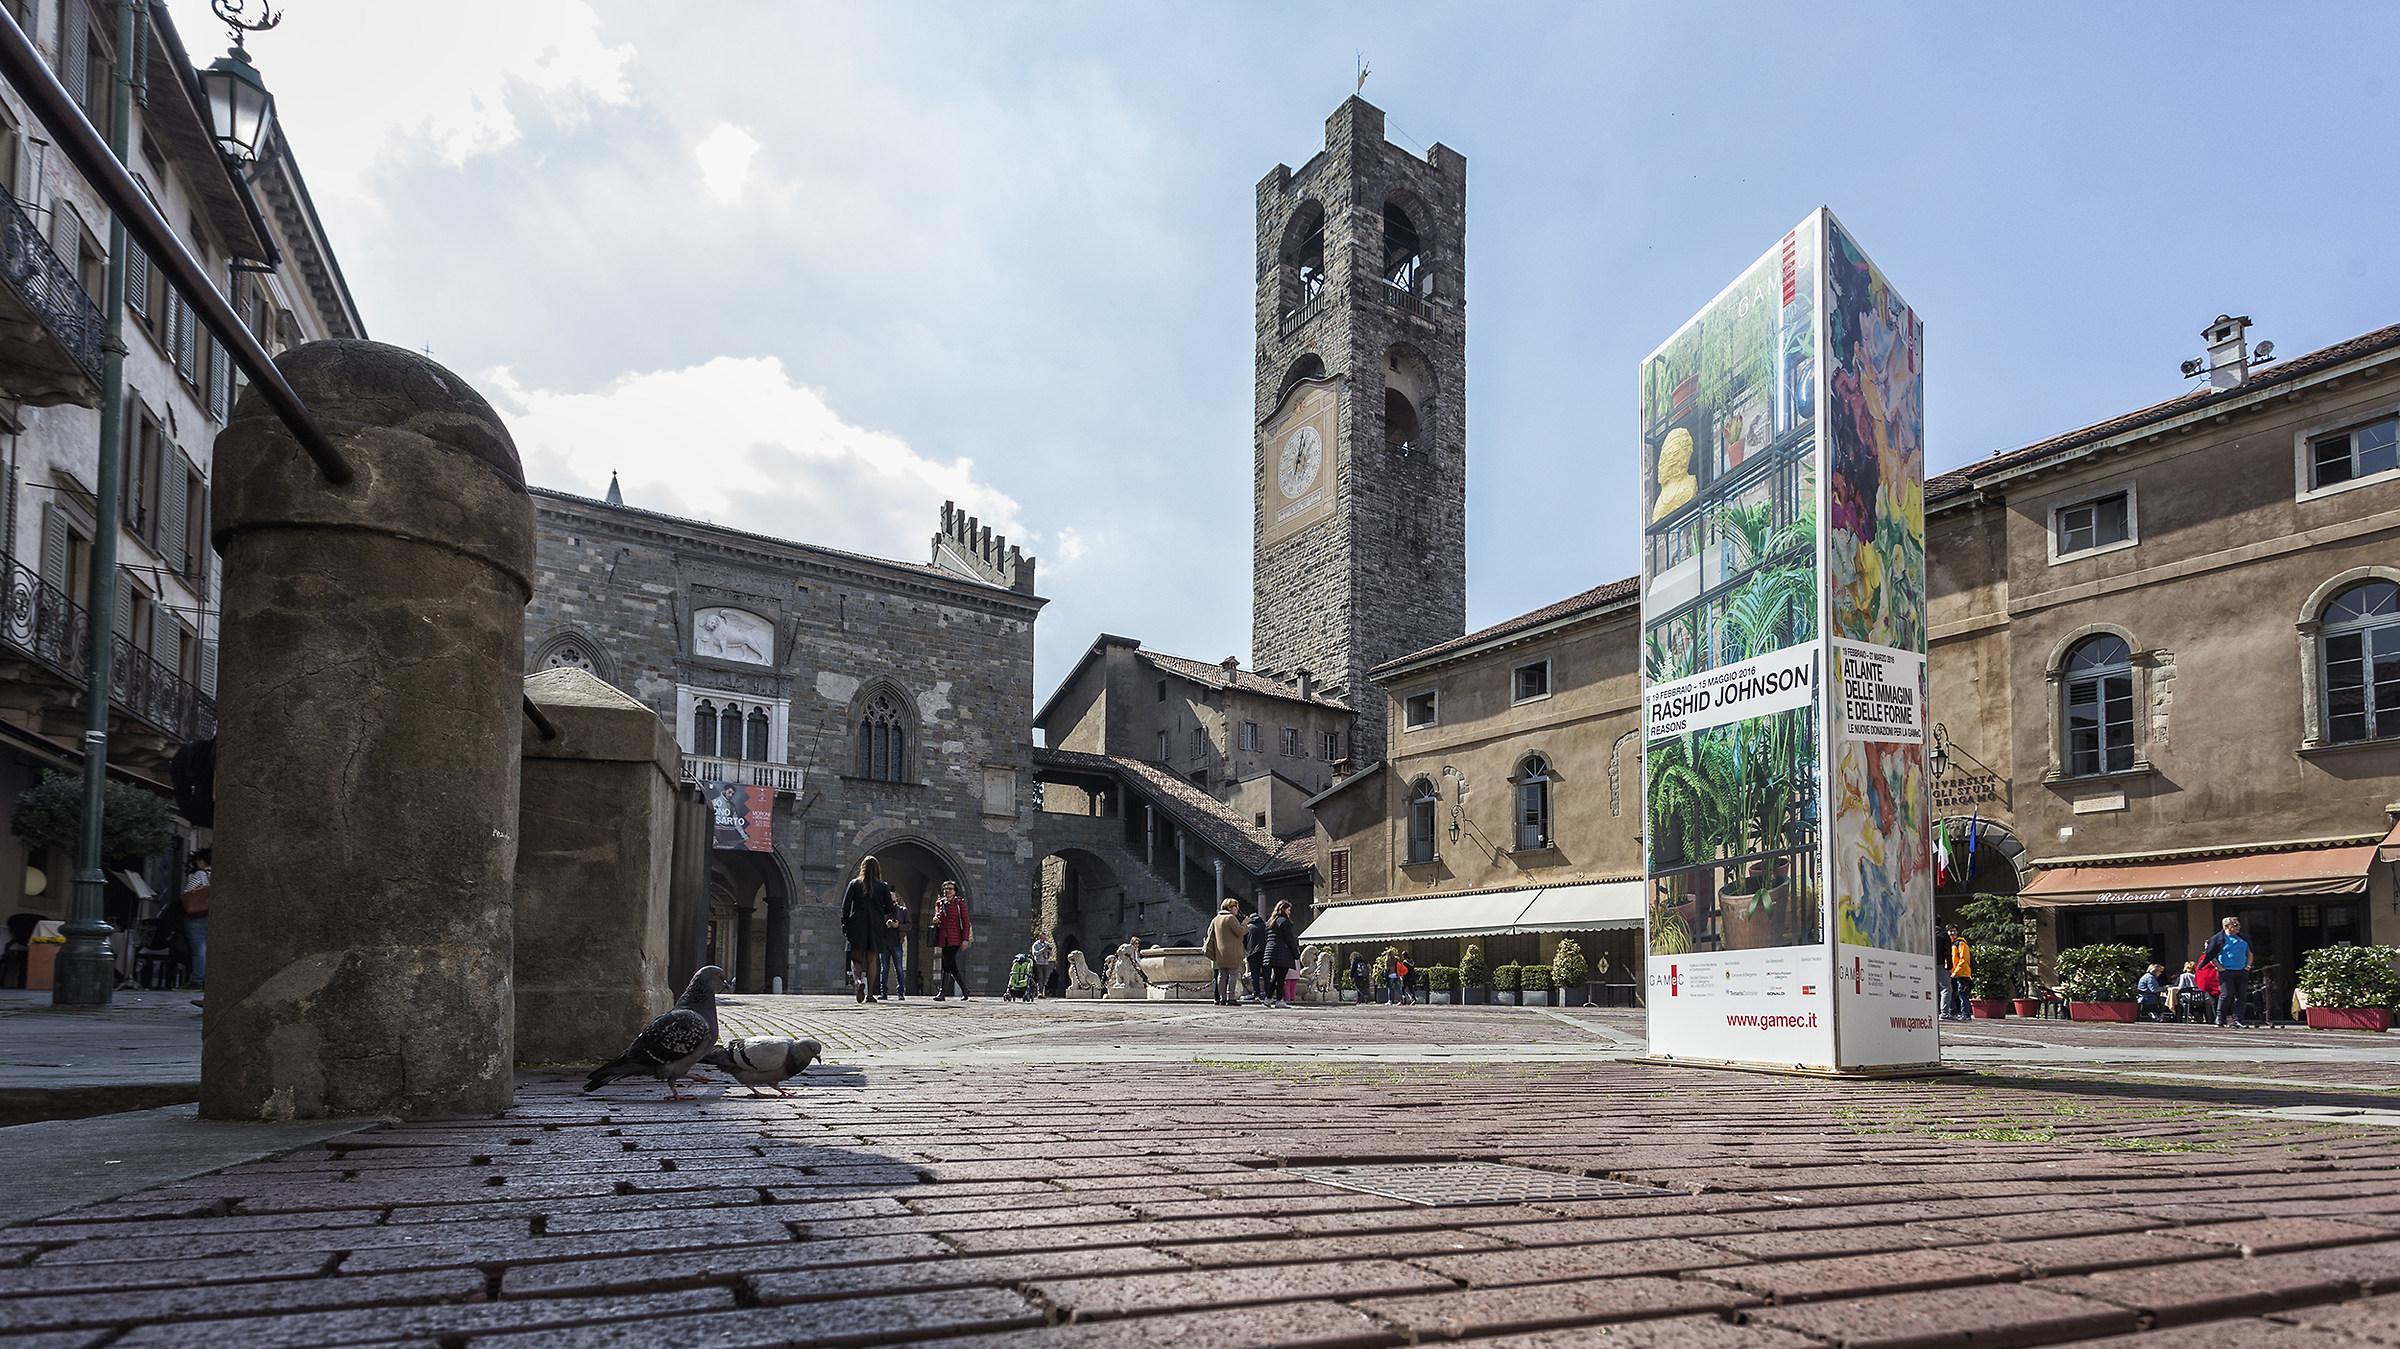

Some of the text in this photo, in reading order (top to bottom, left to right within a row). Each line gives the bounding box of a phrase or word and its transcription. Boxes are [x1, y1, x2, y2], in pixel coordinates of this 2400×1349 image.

[1844, 658, 1883, 682] ATLANTE
[1660, 684, 1692, 699] FEBBRAIO
[1699, 680, 1706, 689] 15
[1707, 671, 1737, 687] MAGGIO
[1739, 666, 1756, 678] 2016
[1652, 664, 1809, 722] RASHID JOHNSON
[1845, 679, 1913, 705] DELLE IMMAGINI
[1847, 700, 1912, 724] E DELLE FORME
[1651, 720, 1687, 736] REASONS
[1848, 724, 1854, 733] LE
[1855, 724, 1870, 734] NUOVE
[1870, 725, 1893, 736] DONAZIONI
[1894, 727, 1902, 736] PER
[1933, 784, 1996, 798] GLI STUDI
[1936, 793, 1995, 806] BERGAMO
[716, 816, 744, 825] SARTO
[2096, 890, 2171, 902] Ristorante
[2199, 884, 2264, 898] Michele
[1649, 973, 1684, 986] GAMeC
[1727, 1012, 1817, 1031] www.gamec.it
[1890, 1015, 1933, 1032] www.gamec.it
